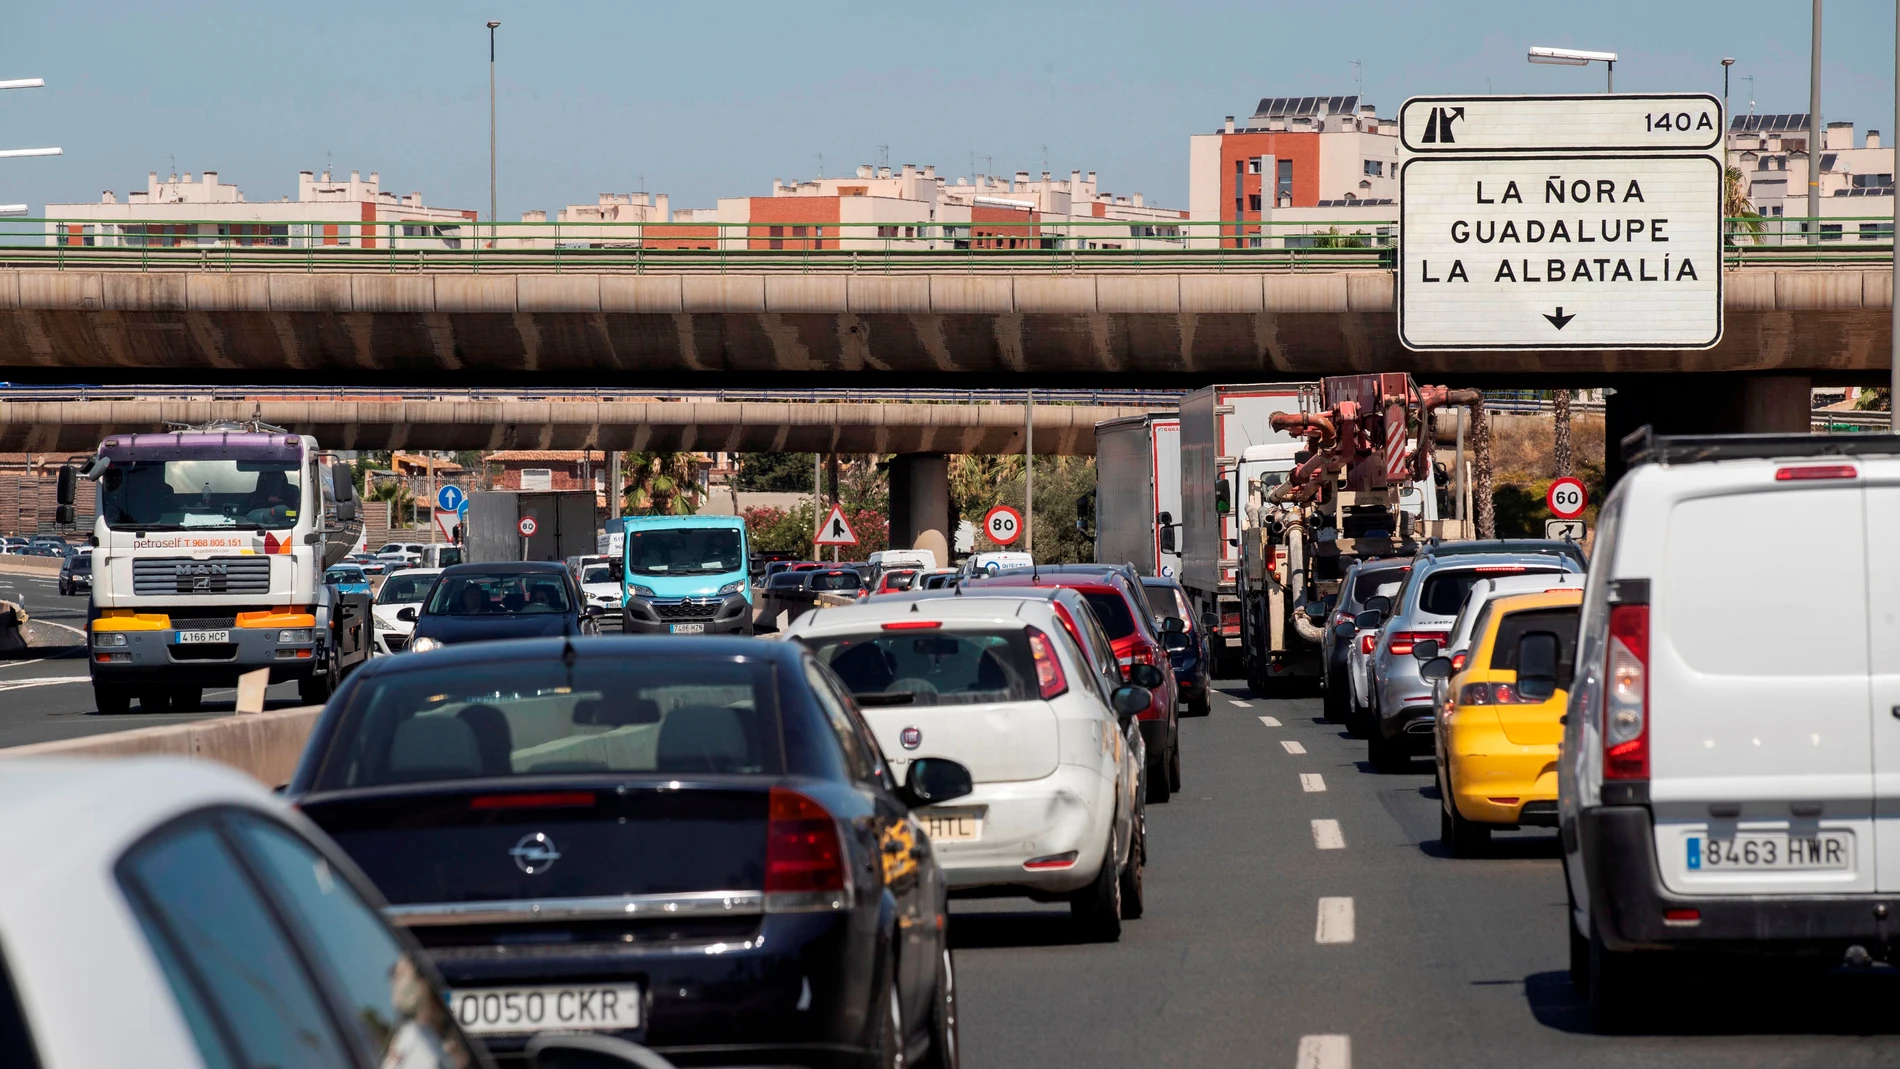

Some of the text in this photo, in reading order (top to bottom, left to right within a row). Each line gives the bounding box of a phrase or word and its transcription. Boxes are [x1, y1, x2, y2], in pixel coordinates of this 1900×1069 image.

[1645, 112, 1713, 132] 140A
[1476, 175, 1646, 204] LA ÑORA
[1451, 218, 1670, 244] GUADALUPE
[1422, 253, 1698, 283] LA ALBATALÍA
[1556, 491, 1579, 504] 60
[993, 518, 1014, 531] 80
[134, 538, 242, 550] petroself T 968 805 151
[176, 564, 227, 575] MAN
[182, 632, 227, 641] 4166 HCP
[929, 817, 971, 837] HTL
[1706, 837, 1842, 866] 8463 HWR
[458, 988, 619, 1026] 0050 CKR
